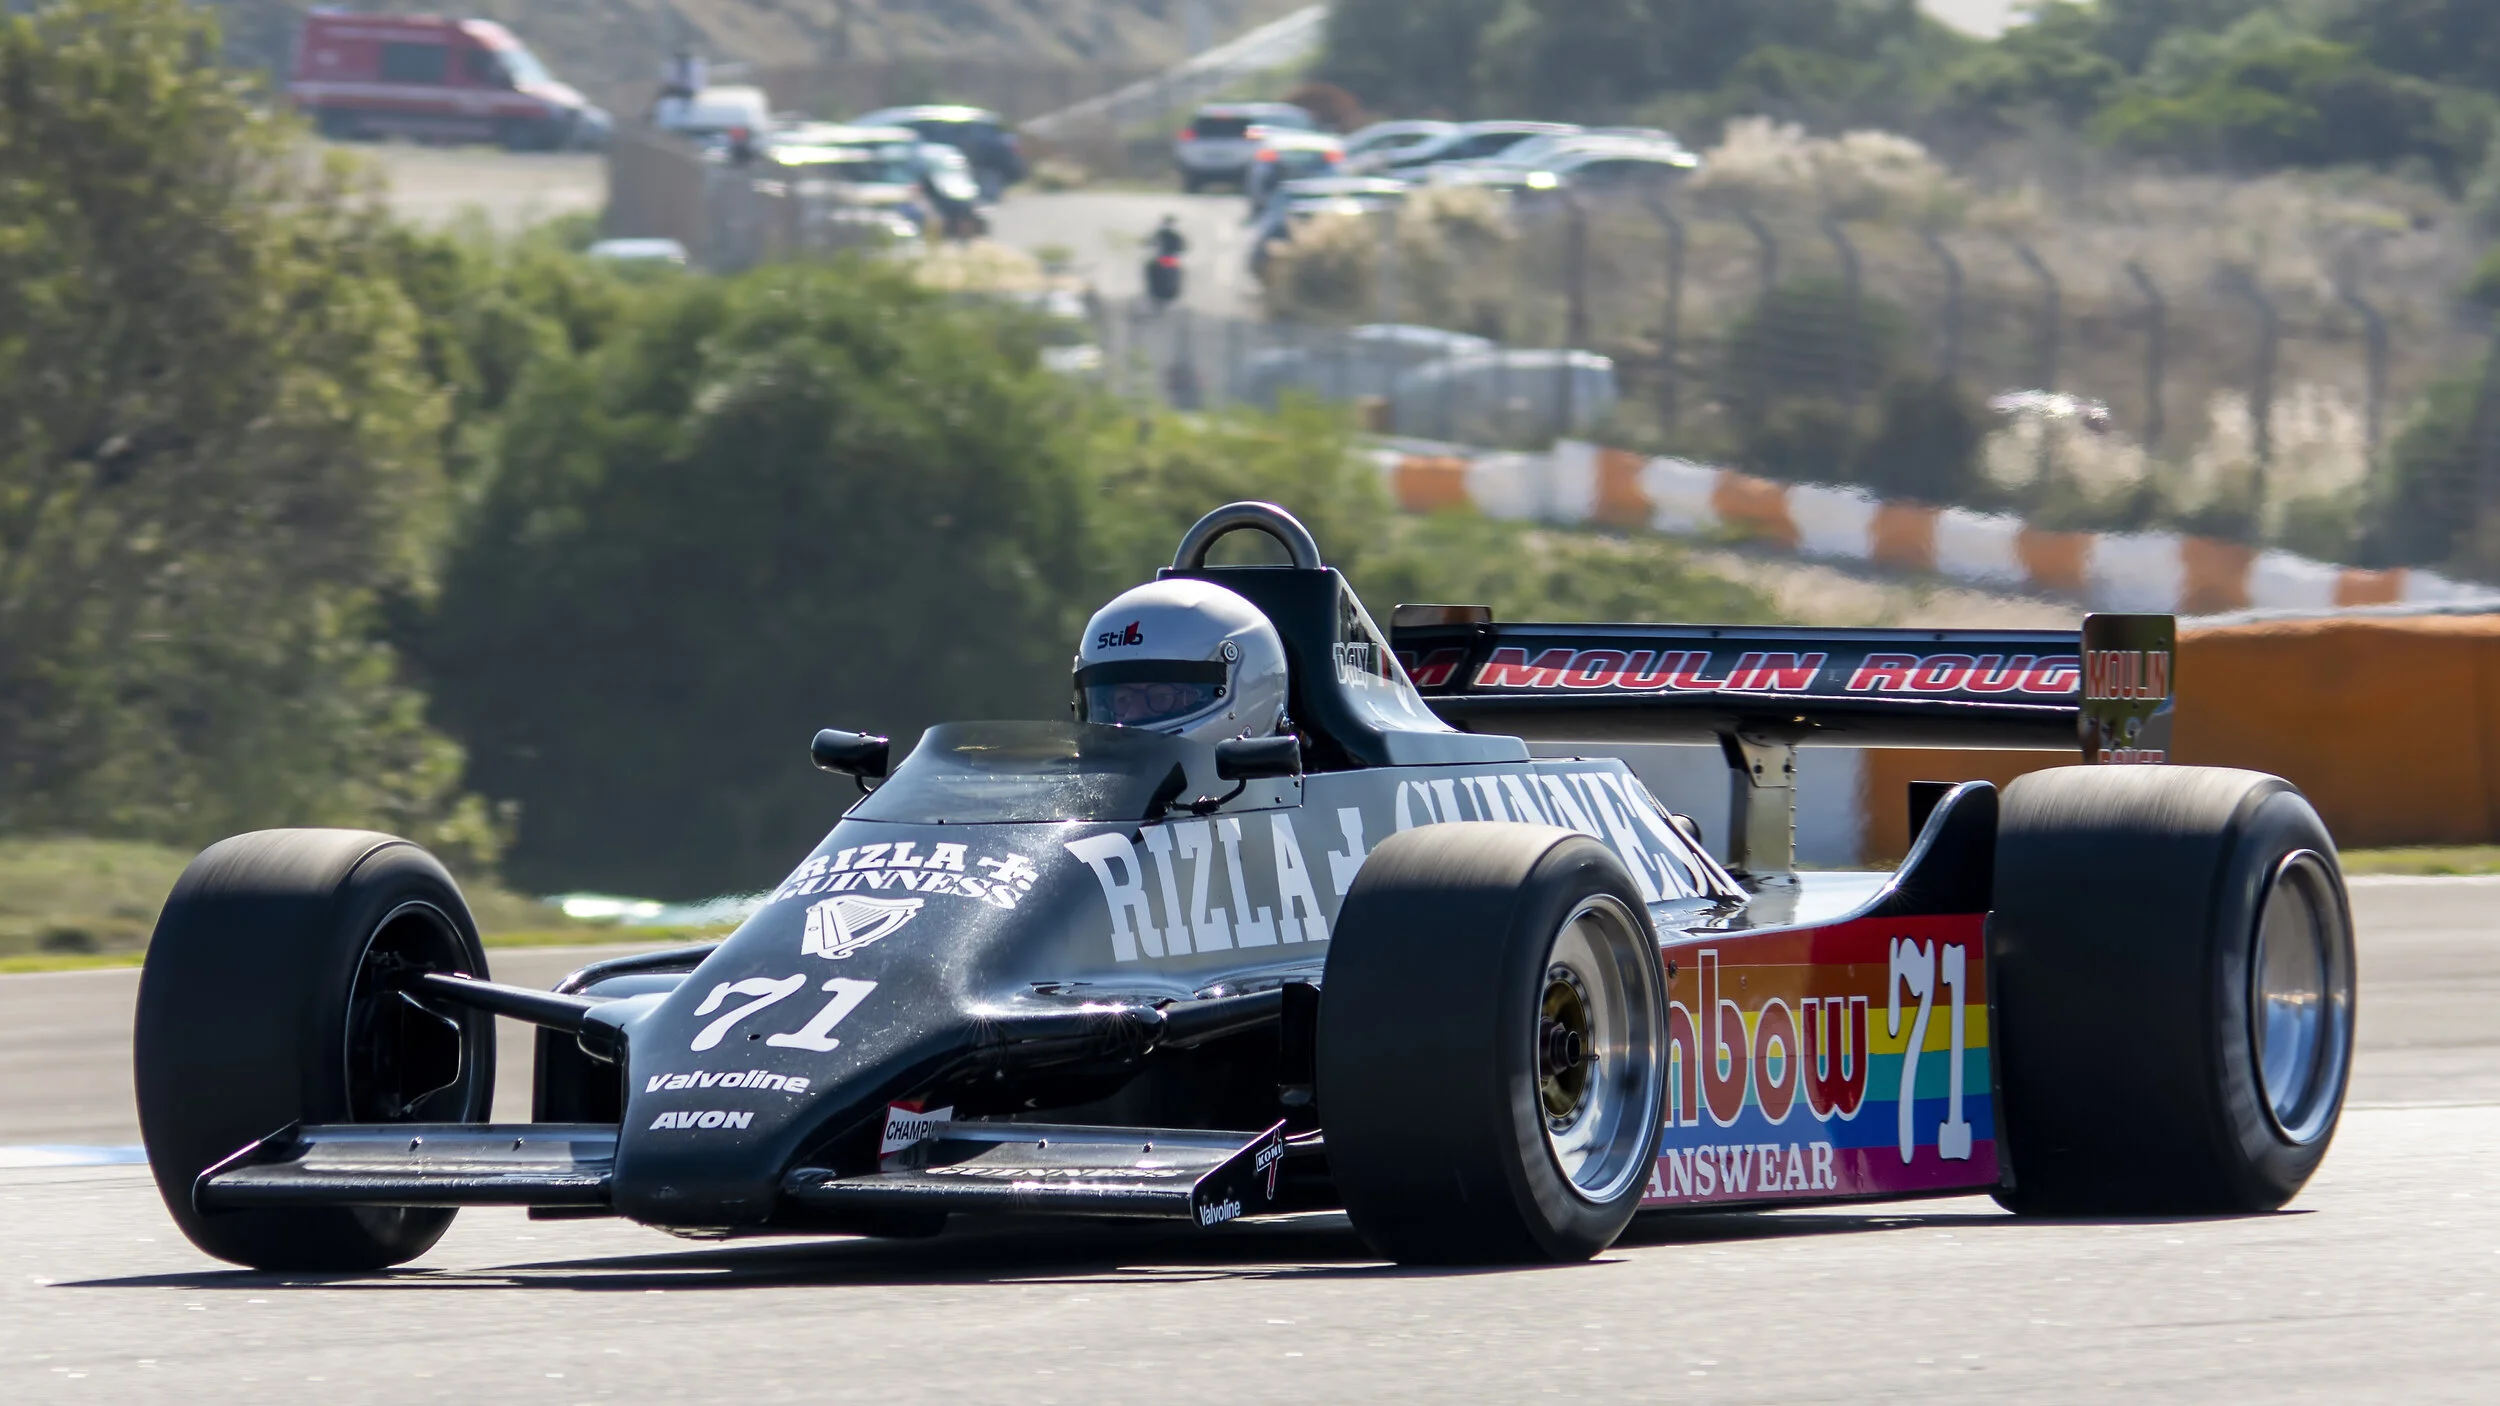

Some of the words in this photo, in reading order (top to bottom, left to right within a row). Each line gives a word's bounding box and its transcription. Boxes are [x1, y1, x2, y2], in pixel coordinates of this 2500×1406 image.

[1472, 647, 1829, 692] MOULIN
[1845, 653, 2080, 694] ROUG
[2086, 650, 2169, 700] MOULIN
[798, 841, 969, 882] RIZLA
[767, 869, 1024, 910] GUINNESS
[1064, 813, 1330, 963] RIZLA
[690, 973, 879, 1052] 71
[645, 1069, 811, 1095] Valvoline
[649, 1110, 755, 1130] AVON
[886, 1120, 935, 1140] CHAMPI
[1258, 1144, 1281, 1166] KONI
[1643, 1141, 1837, 1198] ANSWEAR
[1199, 1198, 1241, 1226] Valvoline
